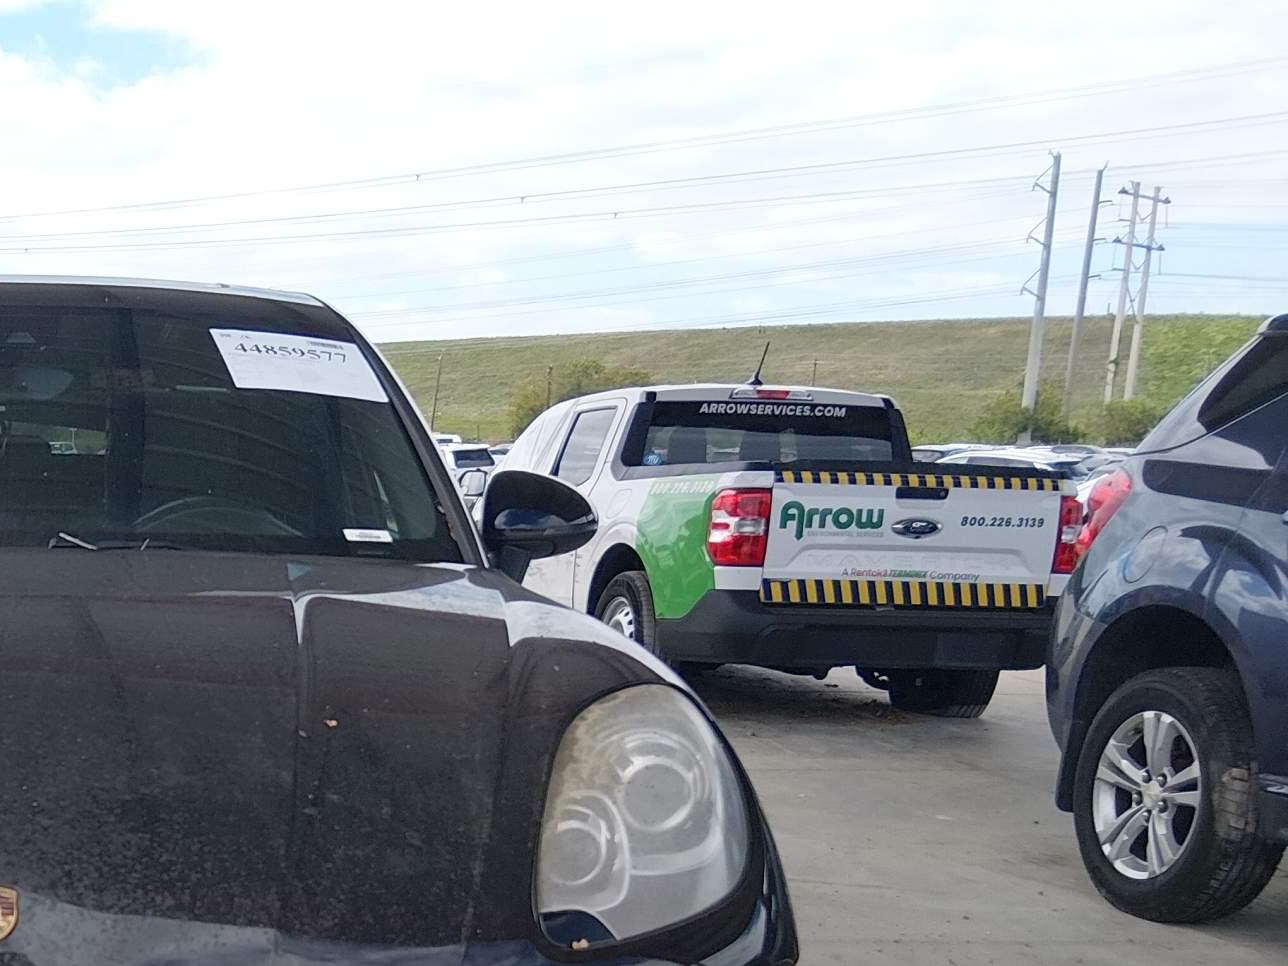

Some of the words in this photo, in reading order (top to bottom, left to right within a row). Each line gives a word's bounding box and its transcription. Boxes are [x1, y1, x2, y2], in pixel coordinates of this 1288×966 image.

[234, 342, 347, 363] 44859577
[699, 403, 847, 418] ARROWSERVICES.COM
[779, 500, 885, 541] Arrow
[960, 516, 1045, 528] 800.226.3139
[841, 567, 849, 577] A
[929, 569, 981, 582] Company
